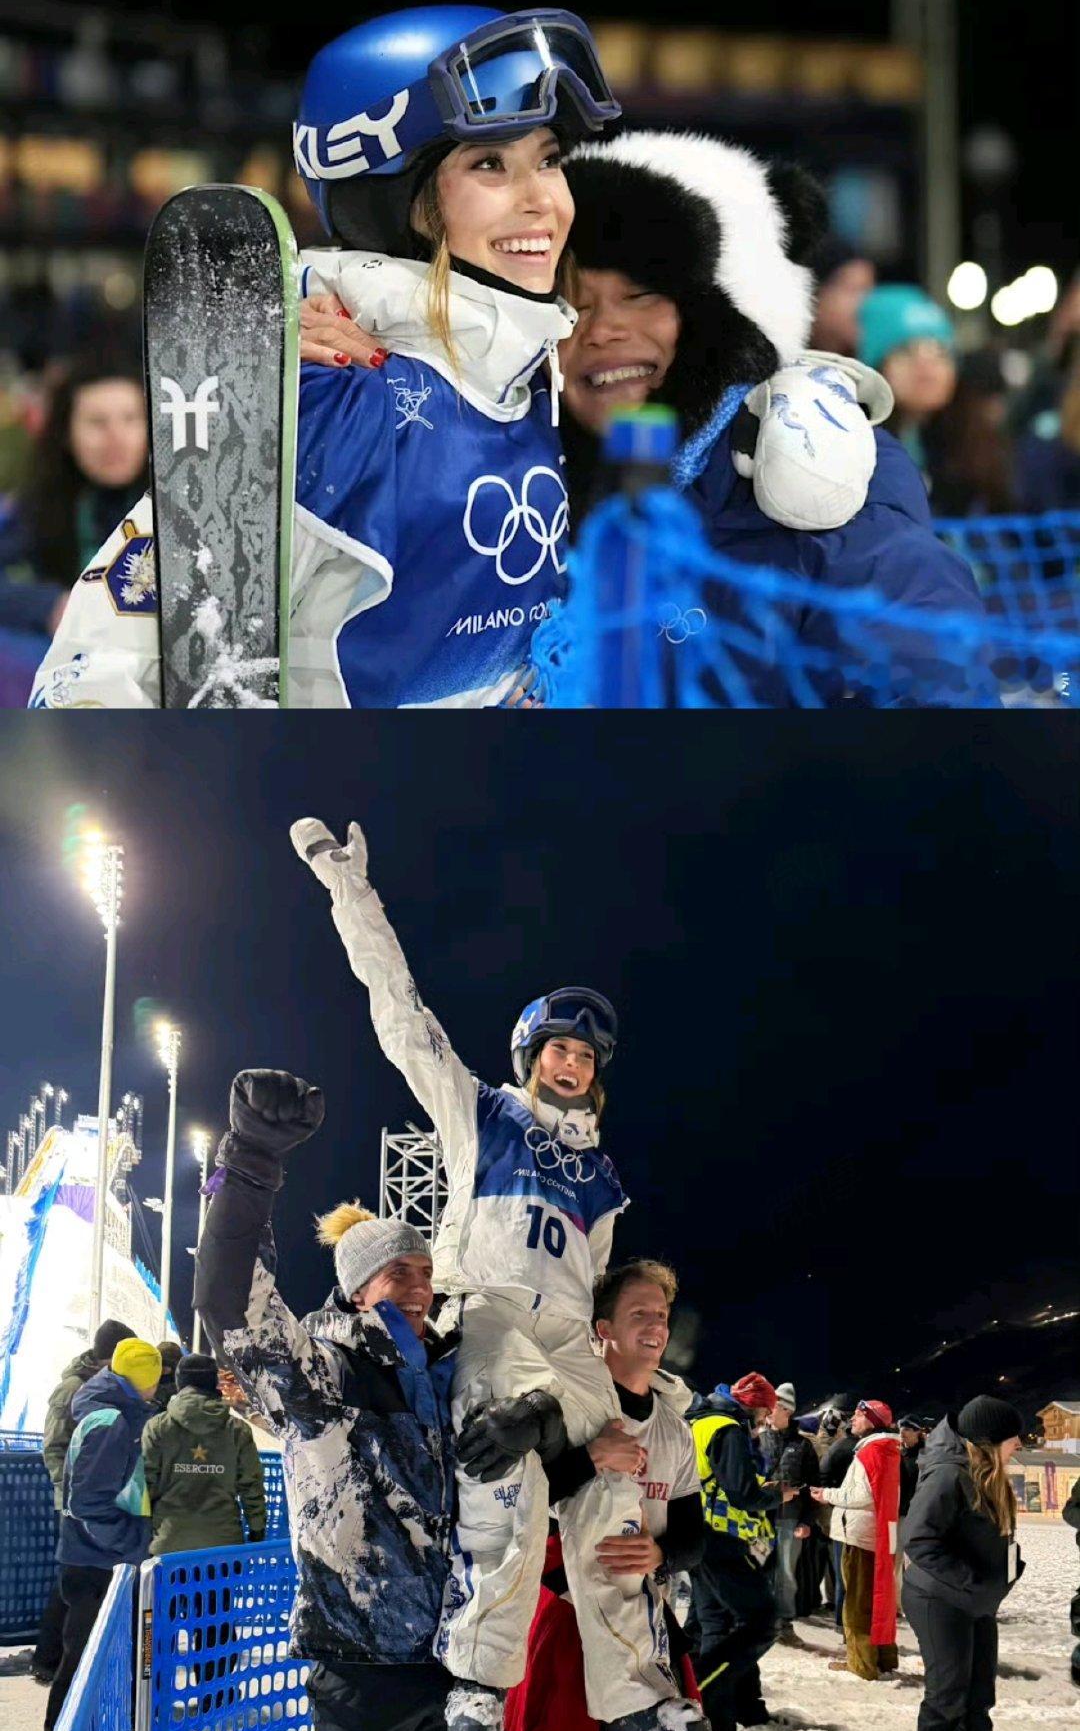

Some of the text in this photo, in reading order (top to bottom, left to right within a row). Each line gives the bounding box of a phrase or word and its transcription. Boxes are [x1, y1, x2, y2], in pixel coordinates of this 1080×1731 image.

[445, 607, 525, 637] MILANO
[526, 1204, 567, 1259] 10
[174, 1463, 225, 1475] ESERCITO
